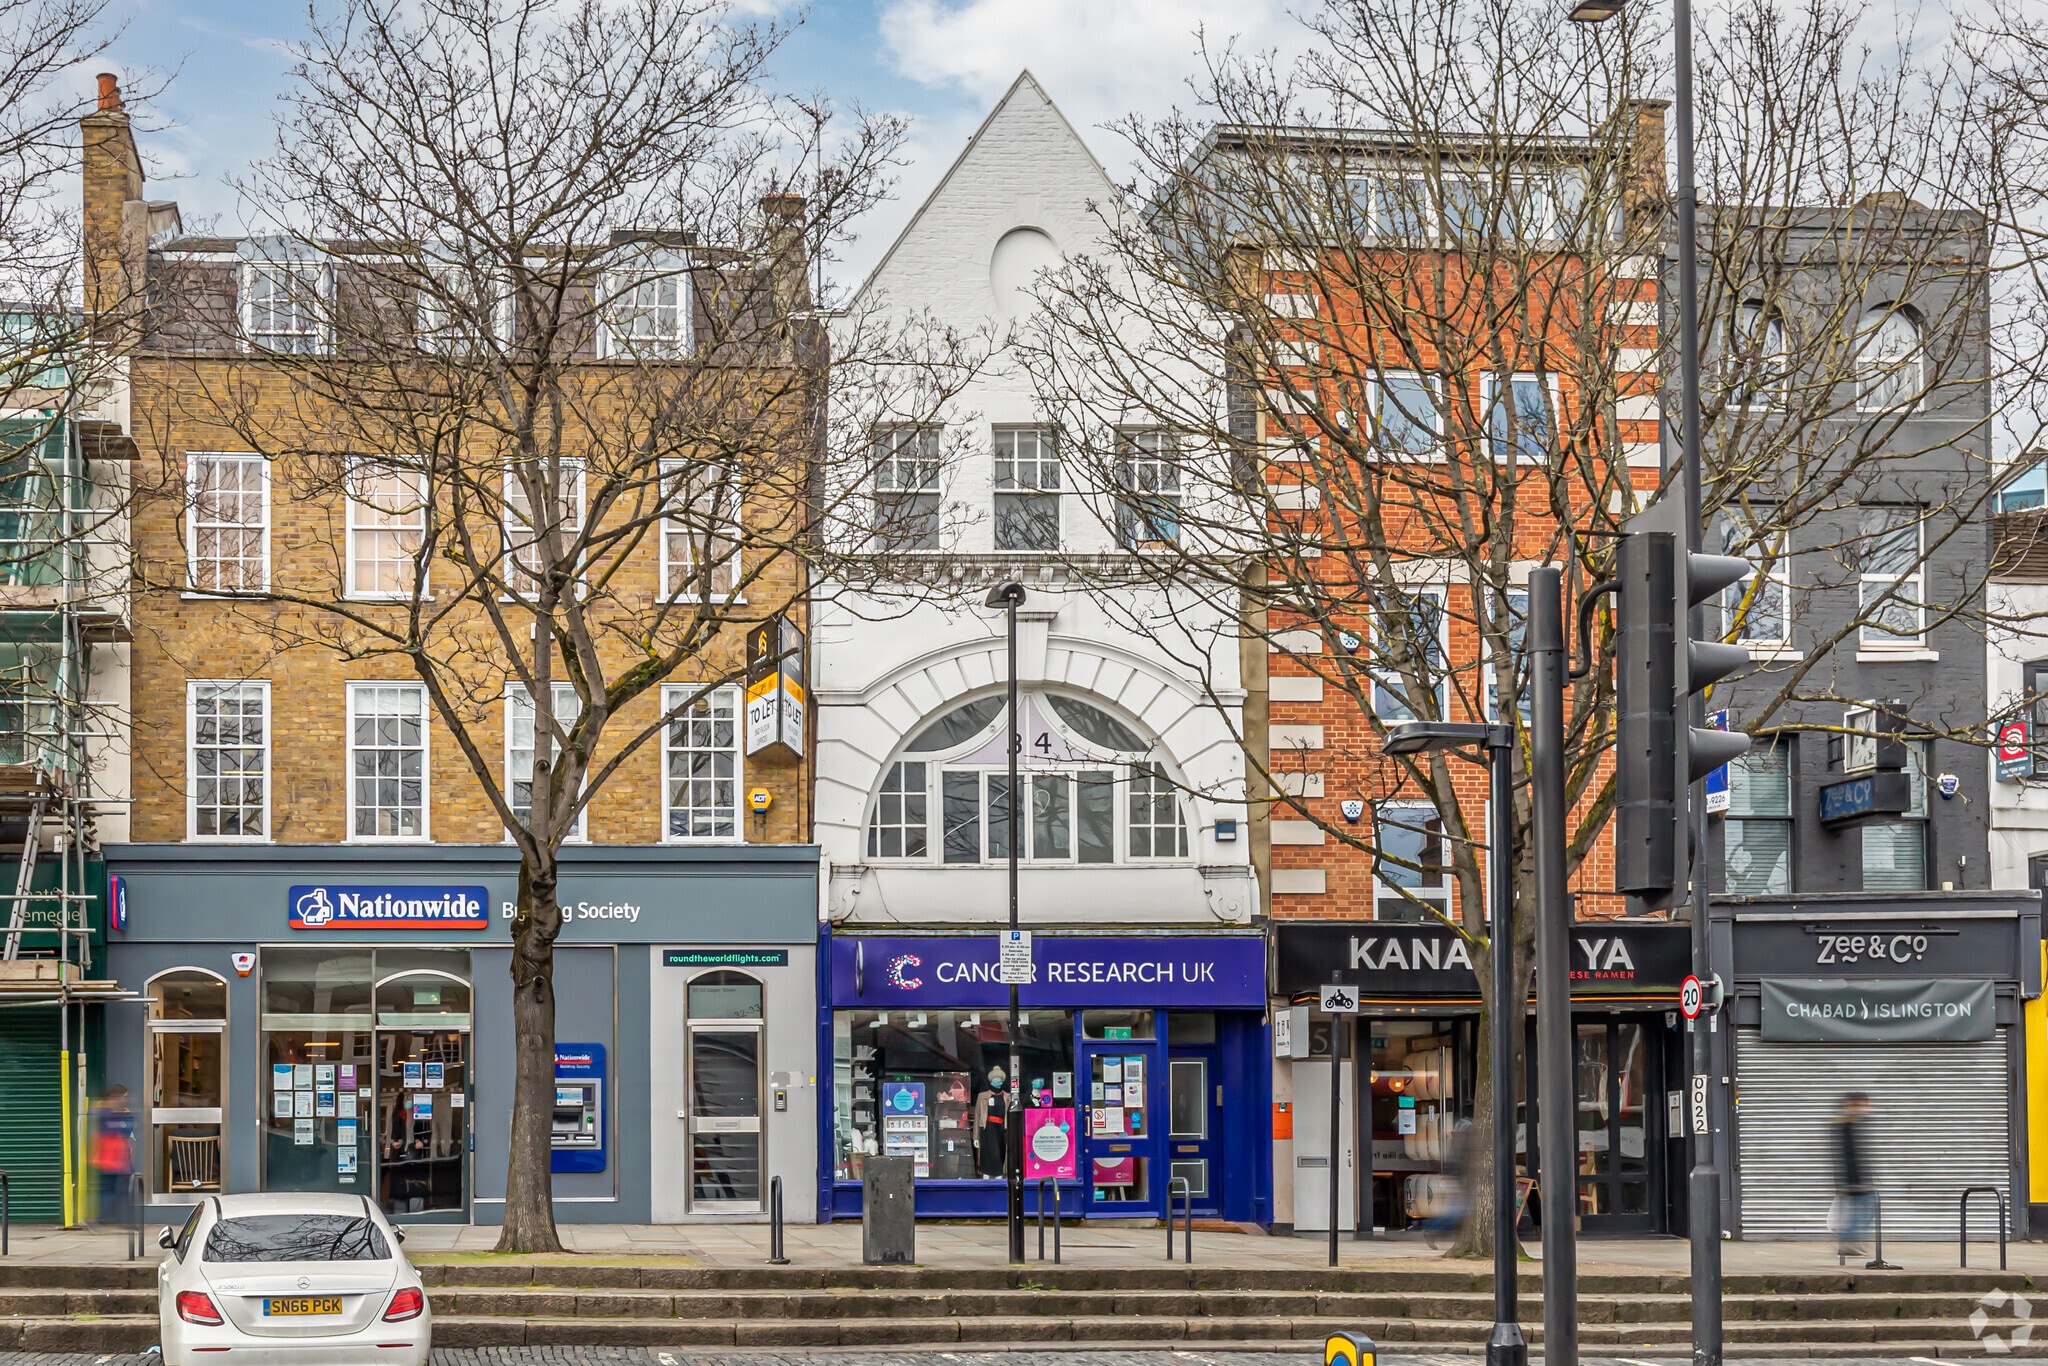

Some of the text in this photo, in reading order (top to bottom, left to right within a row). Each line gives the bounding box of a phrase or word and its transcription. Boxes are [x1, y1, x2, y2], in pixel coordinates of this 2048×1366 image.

[750, 698, 776, 726] TO LET
[338, 893, 480, 918] Nationwide
[577, 901, 641, 923] Society
[1868, 935, 1886, 958] &
[1048, 962, 1174, 983] RESEARCH
[1182, 962, 1215, 983] UK
[1595, 971, 1635, 979] RAMEN
[1684, 988, 1698, 1006] 20
[1786, 1003, 1971, 1018] CHABAD ISLINGTON
[272, 1298, 340, 1313] SN66 PGK
